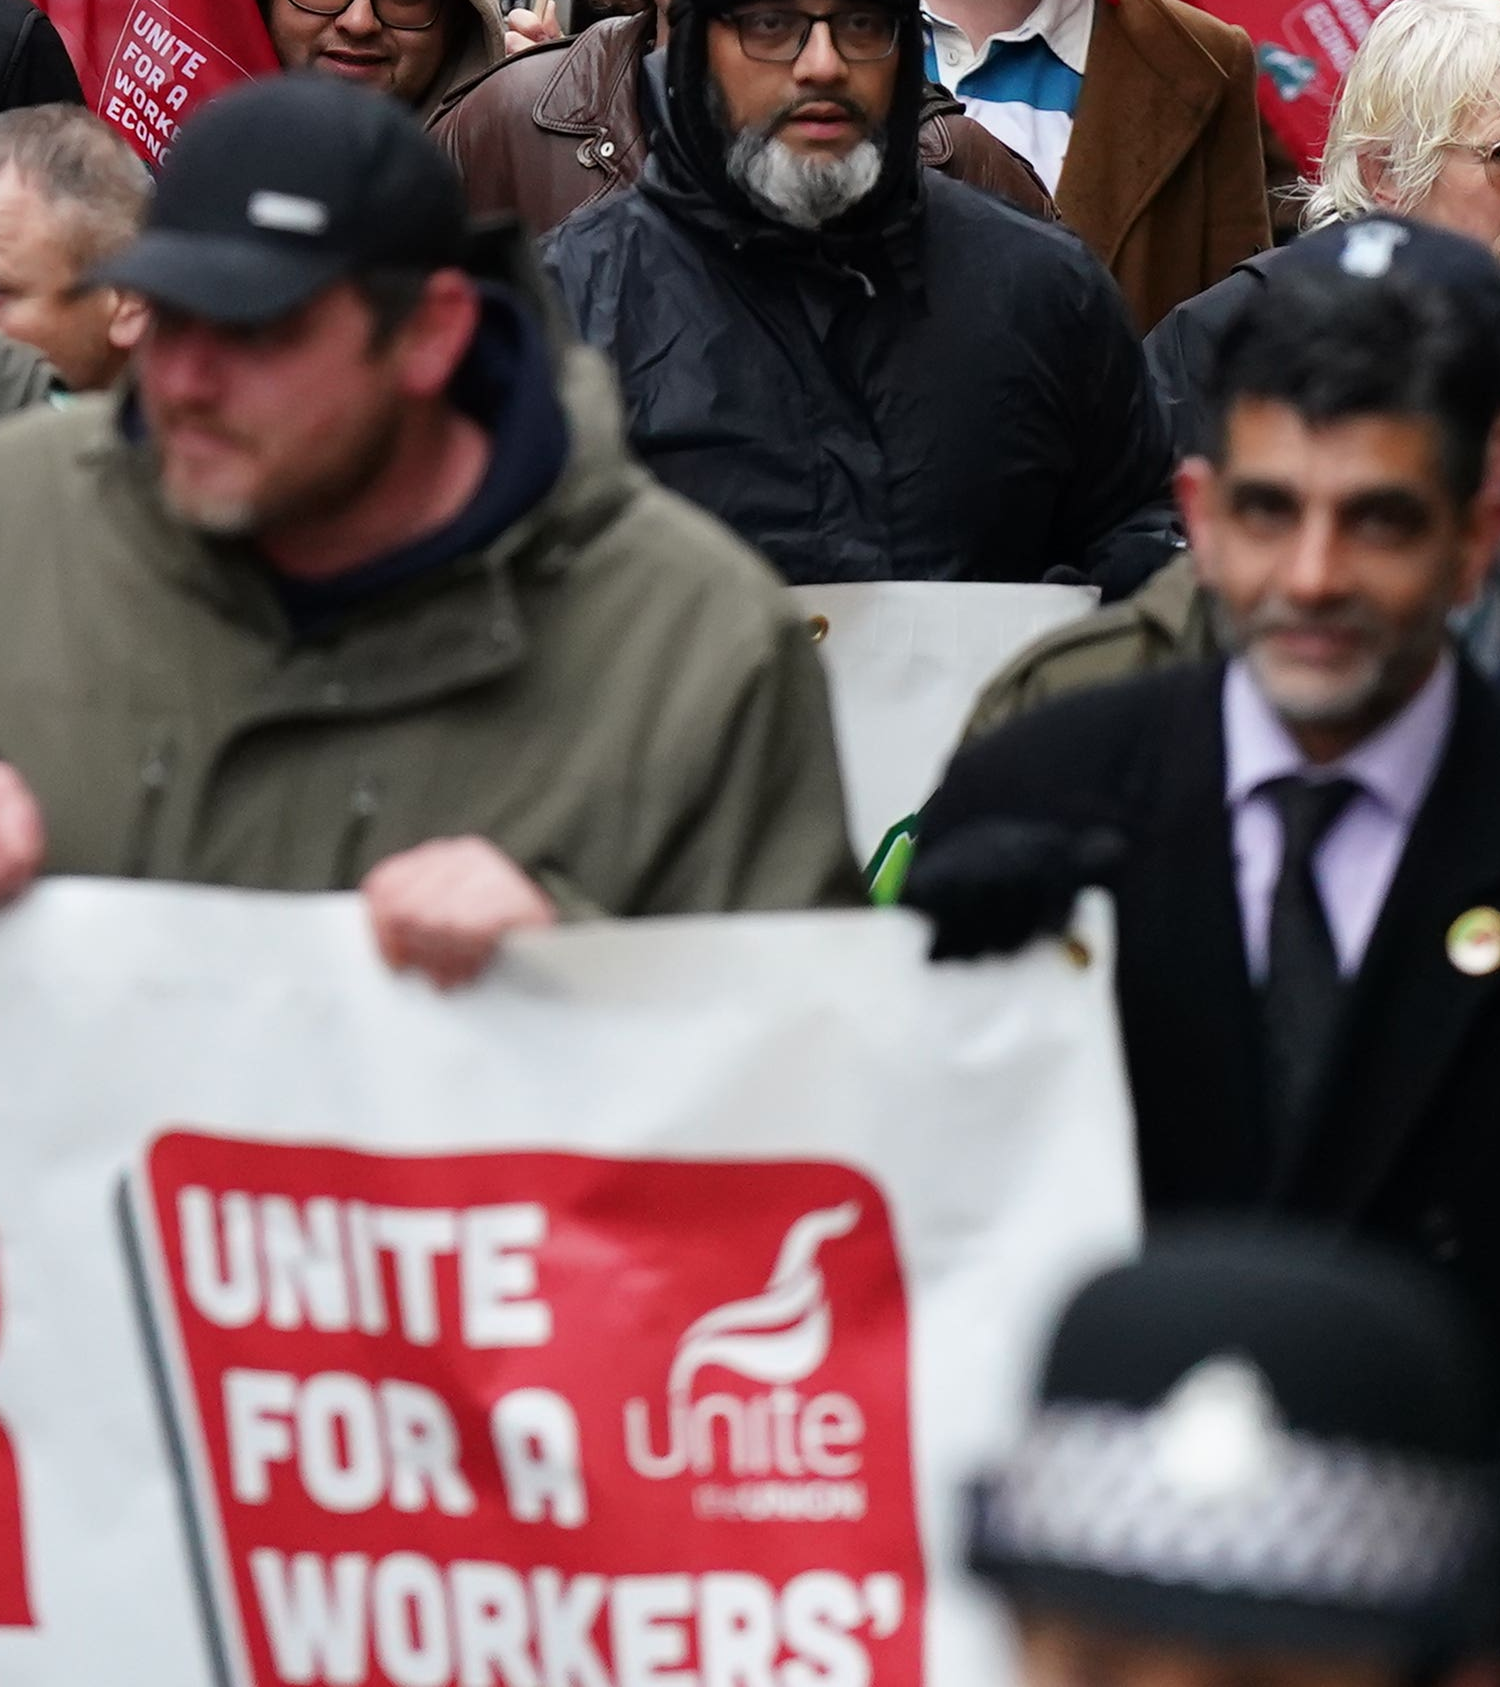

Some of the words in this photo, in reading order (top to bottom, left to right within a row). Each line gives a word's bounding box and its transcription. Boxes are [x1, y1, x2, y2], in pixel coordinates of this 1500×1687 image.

[121, 40, 167, 93] FOR
[164, 83, 189, 112] A
[132, 10, 208, 80] UNITE
[113, 67, 184, 144] WORKE
[177, 1185, 554, 1349] UNITE
[222, 1366, 476, 1518] FOR
[488, 1387, 590, 1530] A
